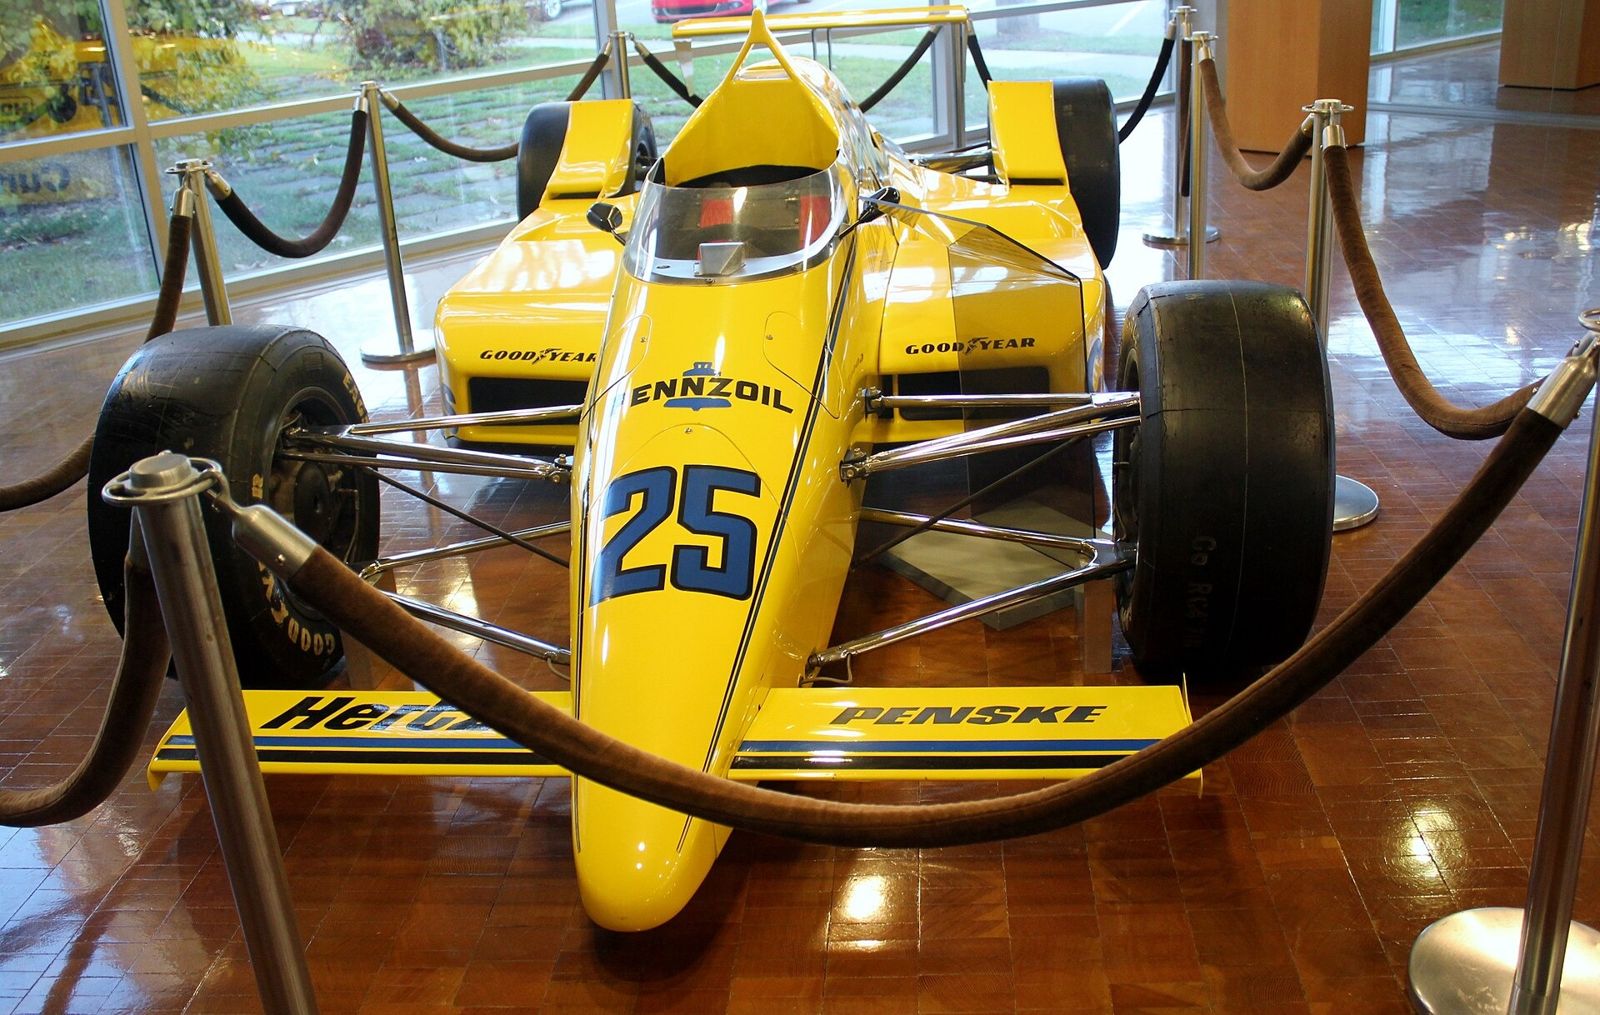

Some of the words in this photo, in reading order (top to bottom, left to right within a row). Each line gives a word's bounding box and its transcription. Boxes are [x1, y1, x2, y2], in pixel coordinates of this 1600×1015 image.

[905, 336, 1036, 355] GOODYEAR
[629, 376, 794, 414] ENNZOIL
[588, 464, 762, 608] 25
[828, 705, 1108, 725] PENSKE
